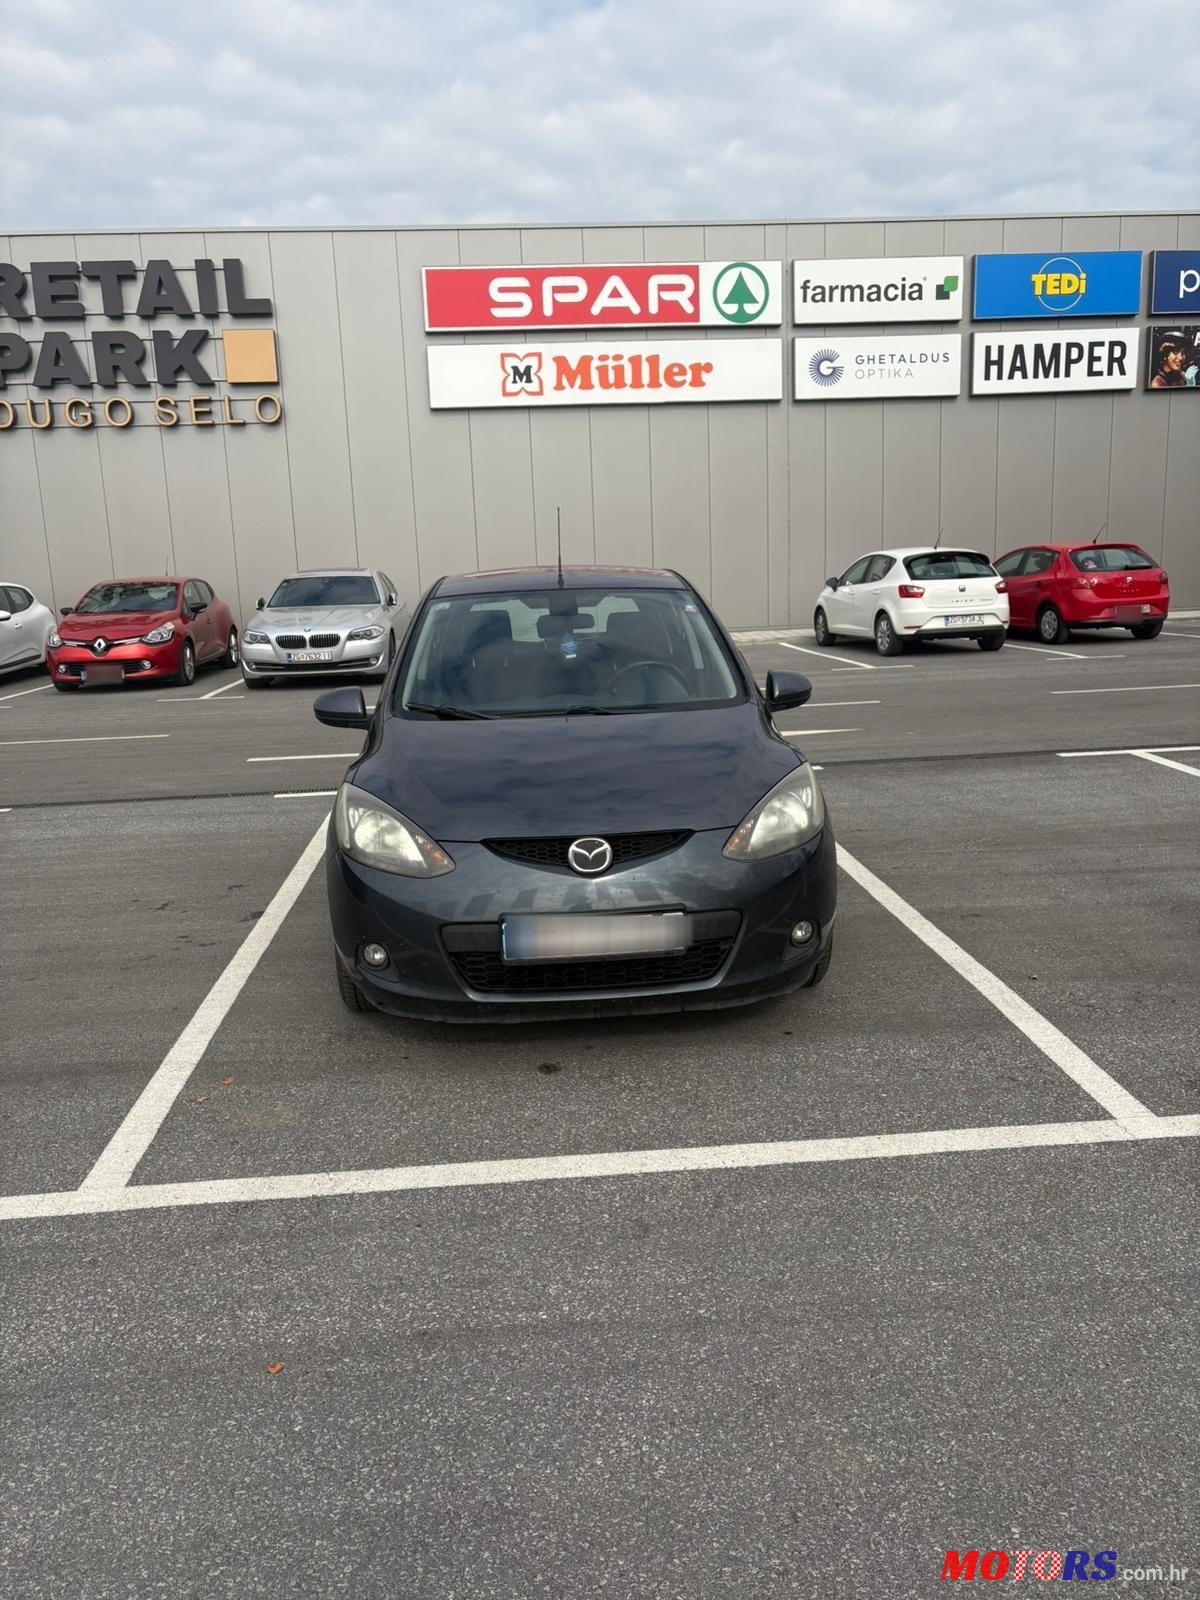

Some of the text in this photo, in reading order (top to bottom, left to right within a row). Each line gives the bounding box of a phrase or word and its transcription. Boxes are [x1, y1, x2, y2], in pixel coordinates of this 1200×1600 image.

[0, 258, 273, 320] RETAIL
[488, 273, 696, 318] SPAR
[800, 277, 924, 303] farmacia
[1031, 272, 1087, 297] TEDi
[0, 328, 215, 388] PARK
[511, 364, 533, 384] M
[552, 353, 713, 391] Müller
[855, 352, 950, 366] GHETALDUS
[855, 368, 915, 381] OPTIKA
[984, 340, 1128, 381] HAMPER
[155, 393, 283, 426] SELO
